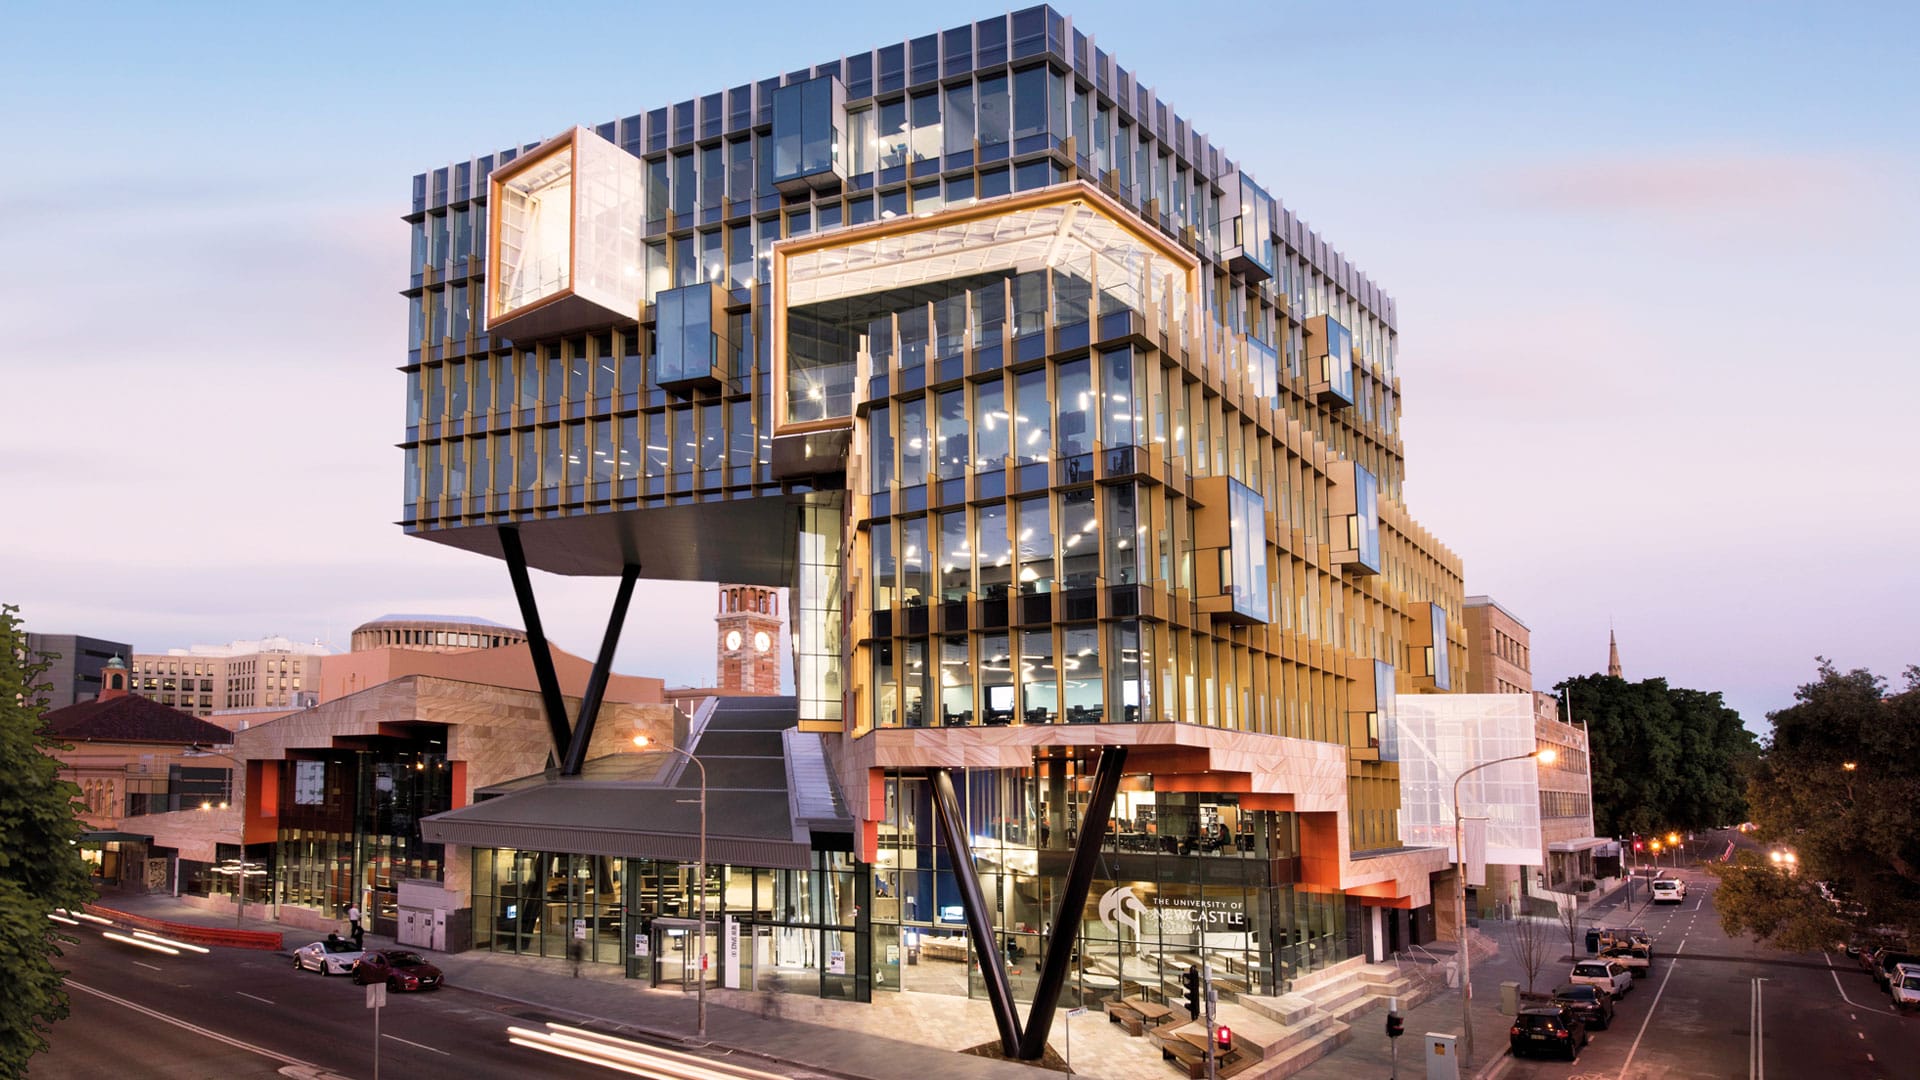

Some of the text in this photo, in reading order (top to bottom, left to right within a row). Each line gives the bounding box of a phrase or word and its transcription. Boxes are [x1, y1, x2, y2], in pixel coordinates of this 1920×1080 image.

[1153, 897, 1169, 905] THE
[1173, 898, 1227, 908] UNIVERSITY
[1153, 907, 1244, 925] NEWCASTLE
